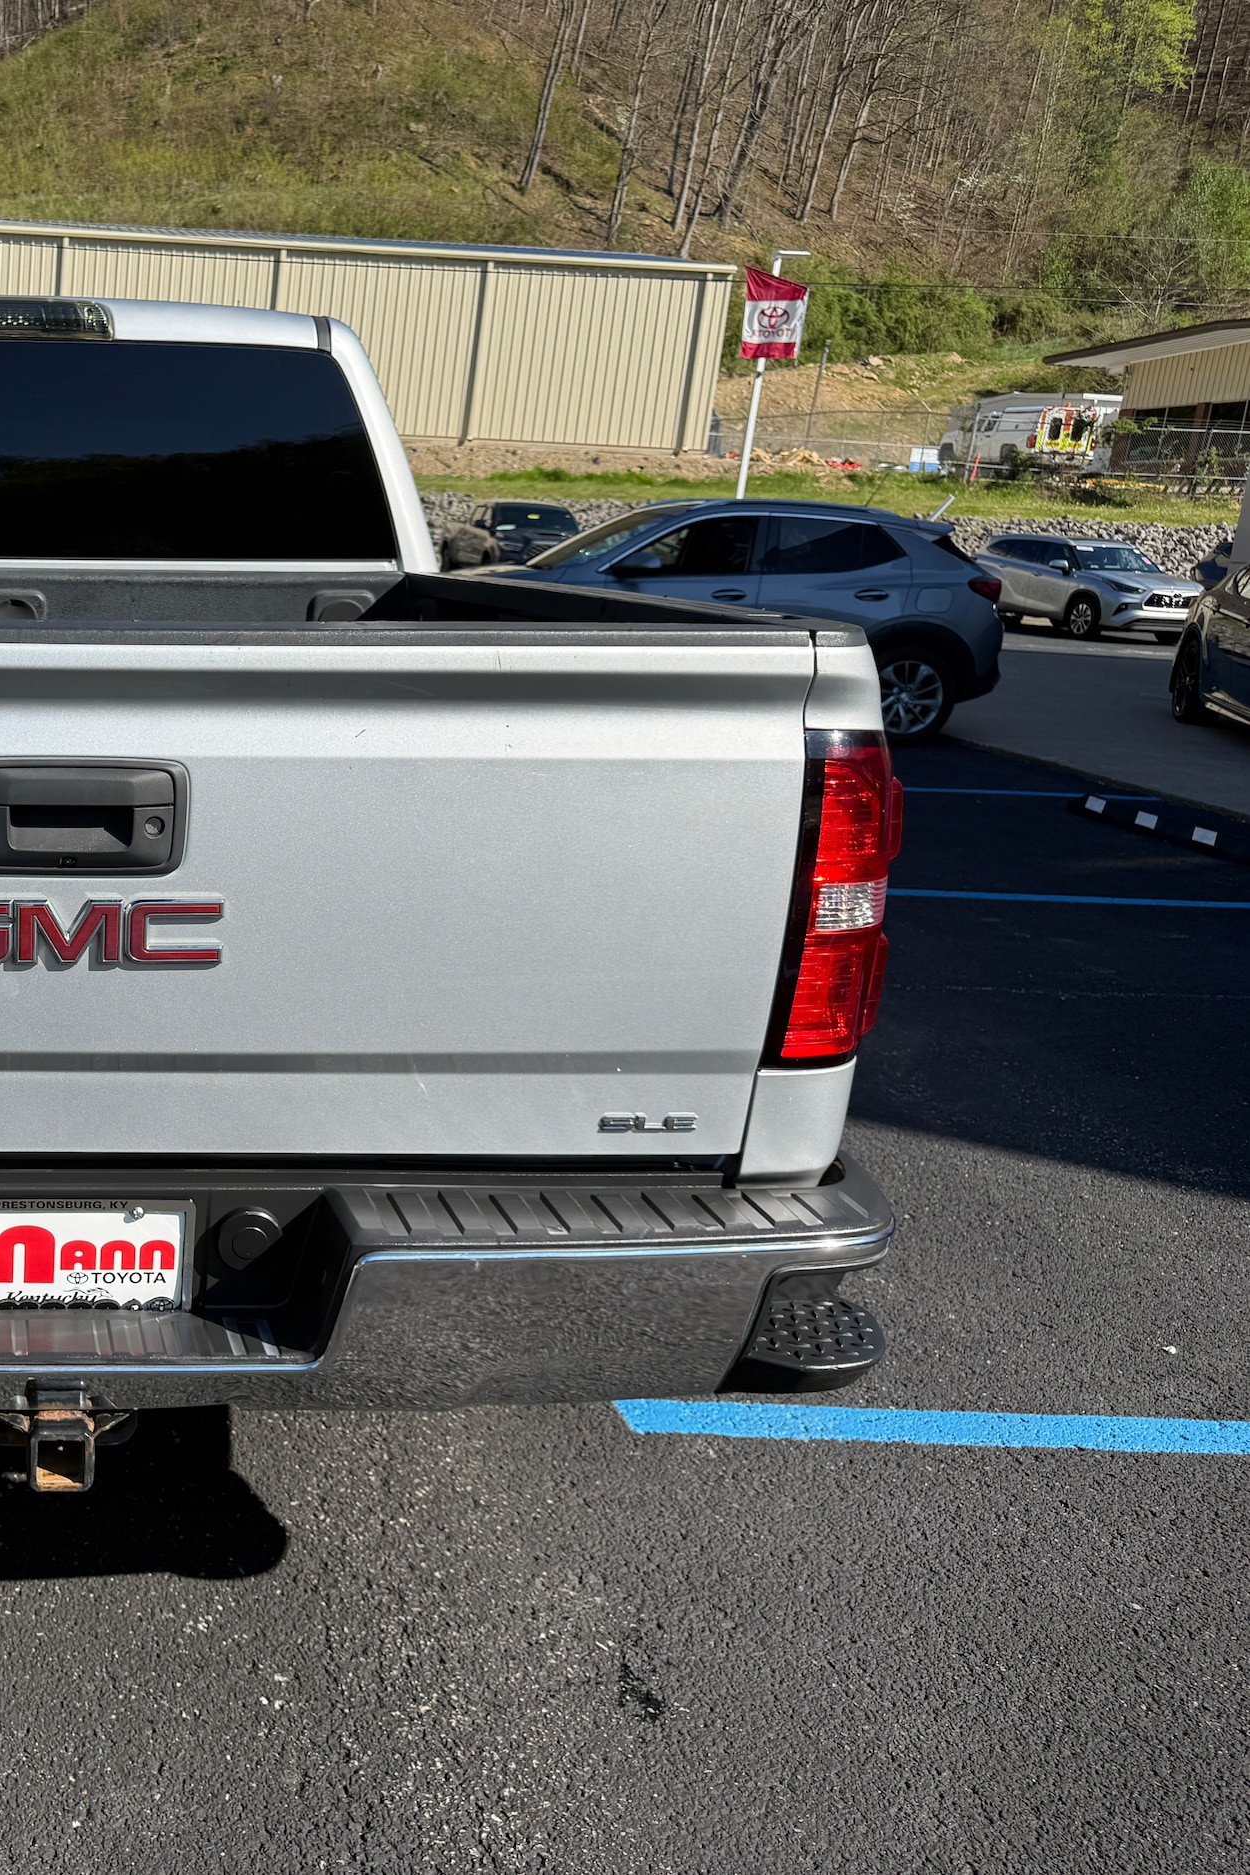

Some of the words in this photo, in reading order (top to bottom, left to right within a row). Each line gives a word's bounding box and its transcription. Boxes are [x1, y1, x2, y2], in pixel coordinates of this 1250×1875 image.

[599, 1111, 699, 1132] SLE
[109, 1200, 129, 1209] KY
[91, 1272, 166, 1284] TOYOTA
